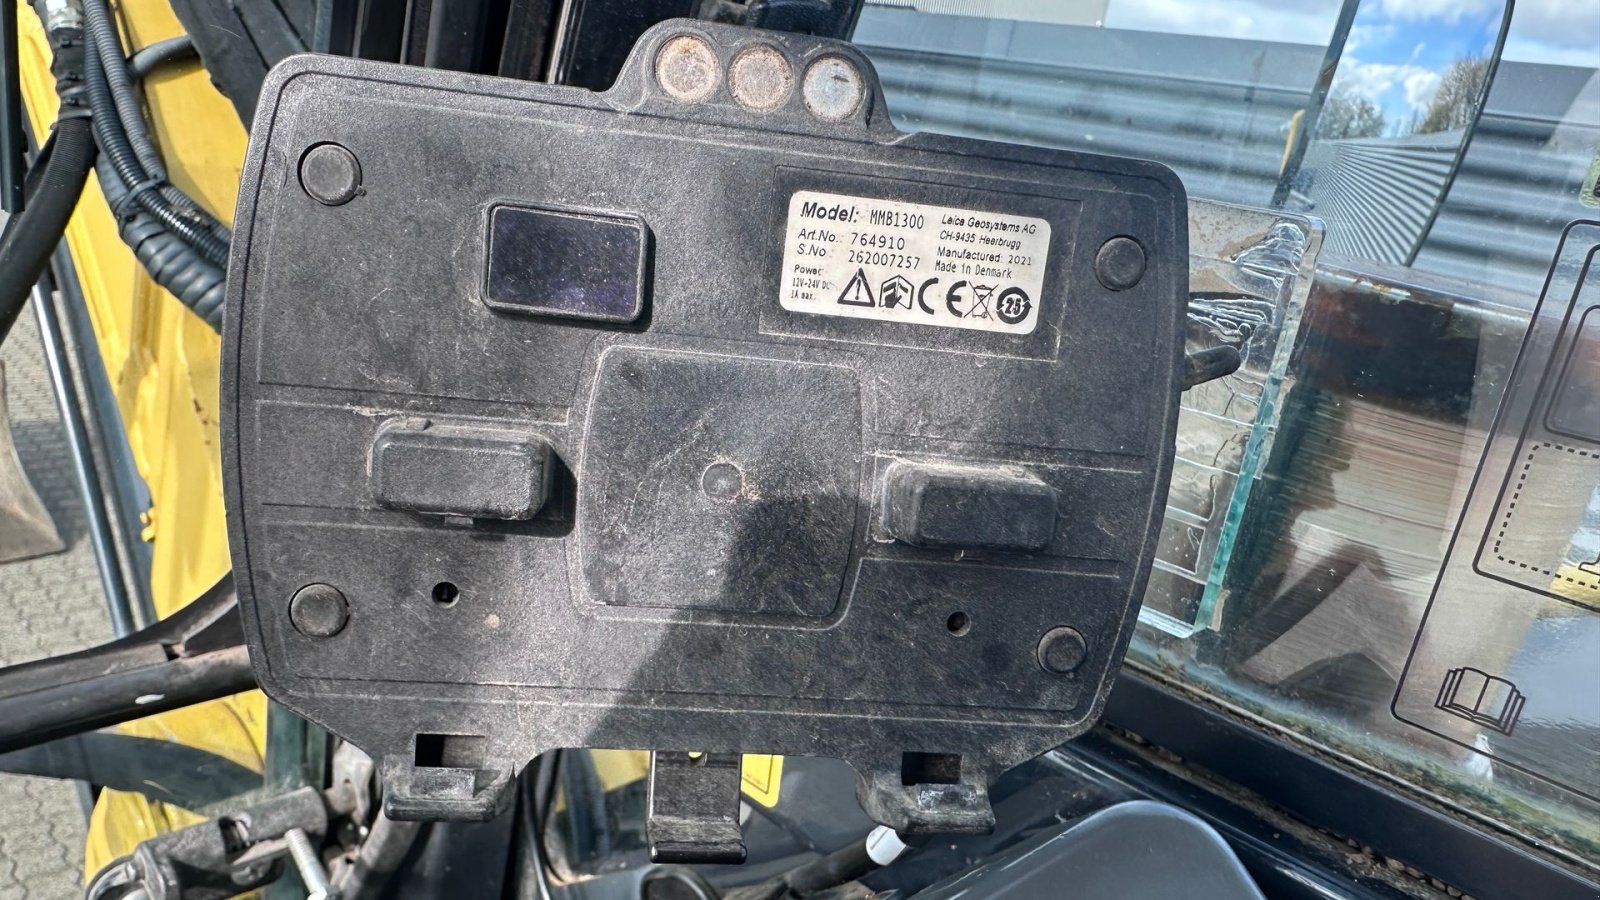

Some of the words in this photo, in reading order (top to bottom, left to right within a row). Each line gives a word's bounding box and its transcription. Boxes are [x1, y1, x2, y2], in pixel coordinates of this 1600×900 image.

[801, 202, 859, 223] Model:
[870, 209, 924, 229] MMB1300
[941, 214, 965, 226] Leica
[967, 217, 1020, 233] Geosystems
[1022, 224, 1037, 235] AG
[851, 232, 905, 250] 764910
[940, 230, 976, 243] CH-9435
[979, 235, 1022, 250] Heerbrugg
[848, 250, 920, 270] 262007257
[934, 260, 957, 273] Made
[961, 263, 971, 274] in
[975, 264, 1013, 279] Denmark
[1008, 254, 1032, 266] 2021
[1004, 297, 1022, 315] 25
